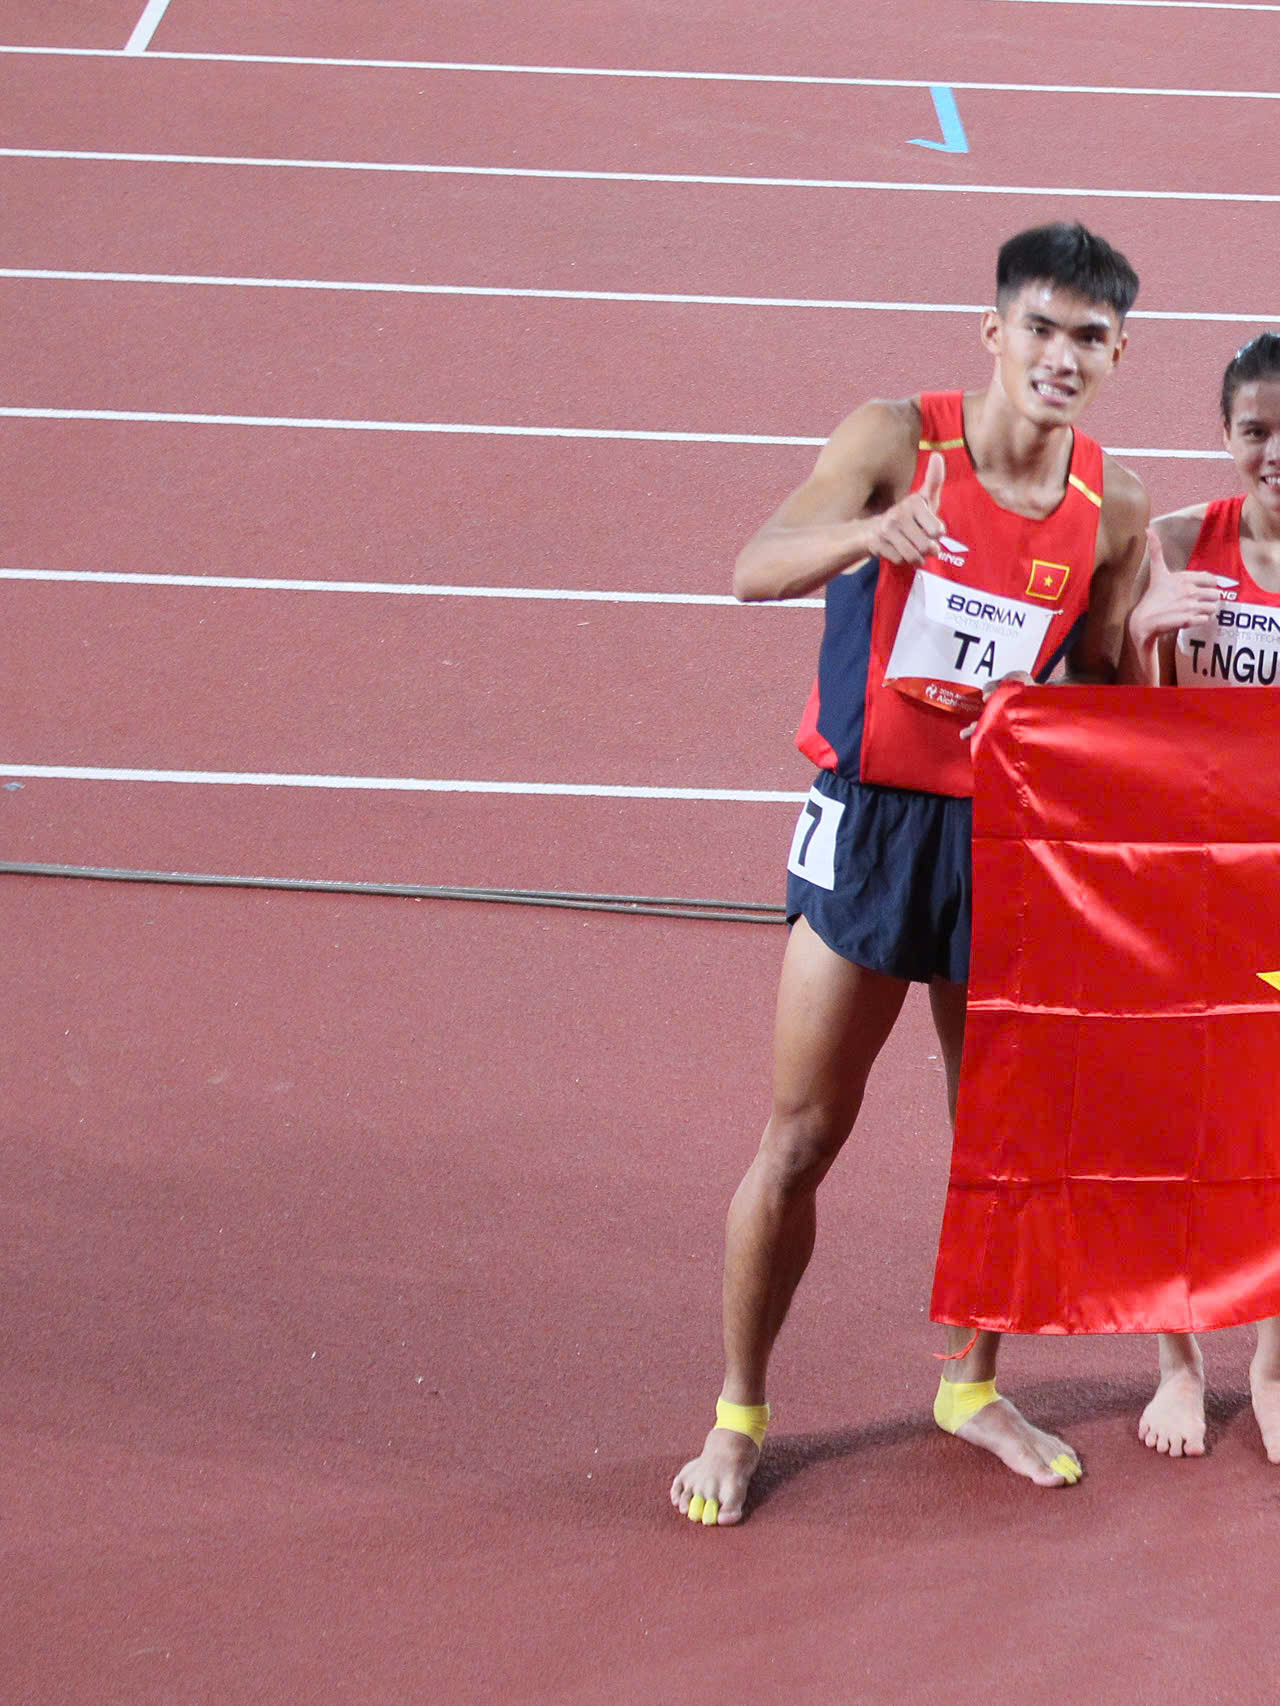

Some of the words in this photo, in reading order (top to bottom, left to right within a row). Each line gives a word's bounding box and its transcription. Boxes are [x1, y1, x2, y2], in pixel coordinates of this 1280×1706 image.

[946, 594, 1026, 628] BORNAN
[953, 630, 996, 677] TA
[798, 798, 823, 867] 7
